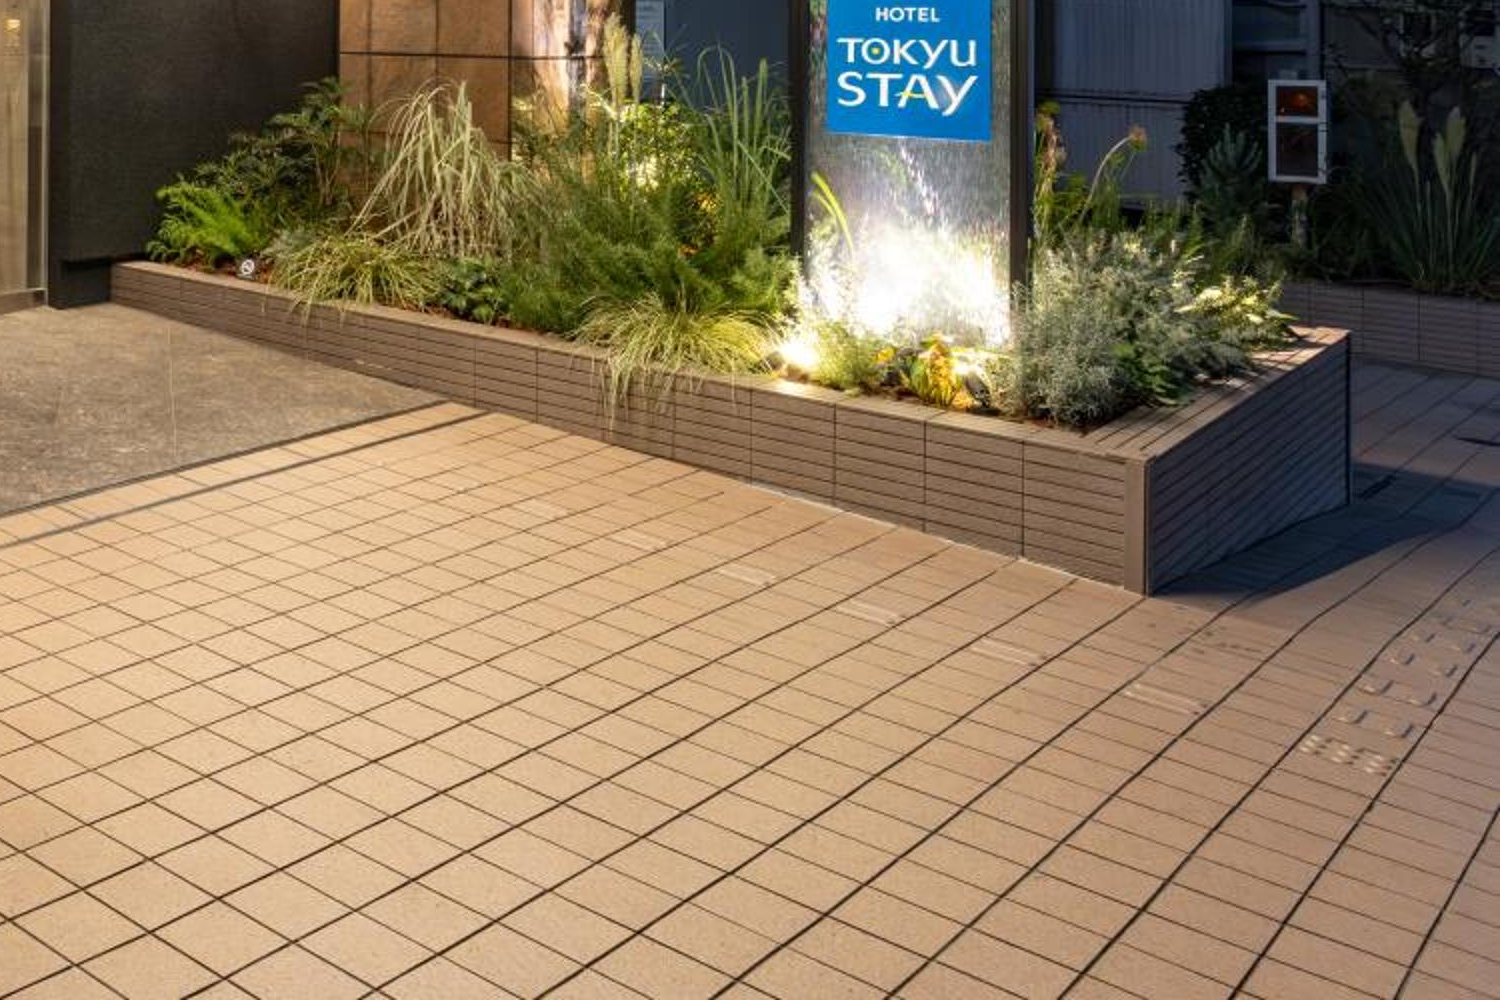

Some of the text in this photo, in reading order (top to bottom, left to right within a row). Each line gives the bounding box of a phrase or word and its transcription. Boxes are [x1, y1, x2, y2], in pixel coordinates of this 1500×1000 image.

[875, 6, 941, 23] HOTEL
[836, 37, 977, 69] TOKYU
[836, 71, 979, 117] STAY
